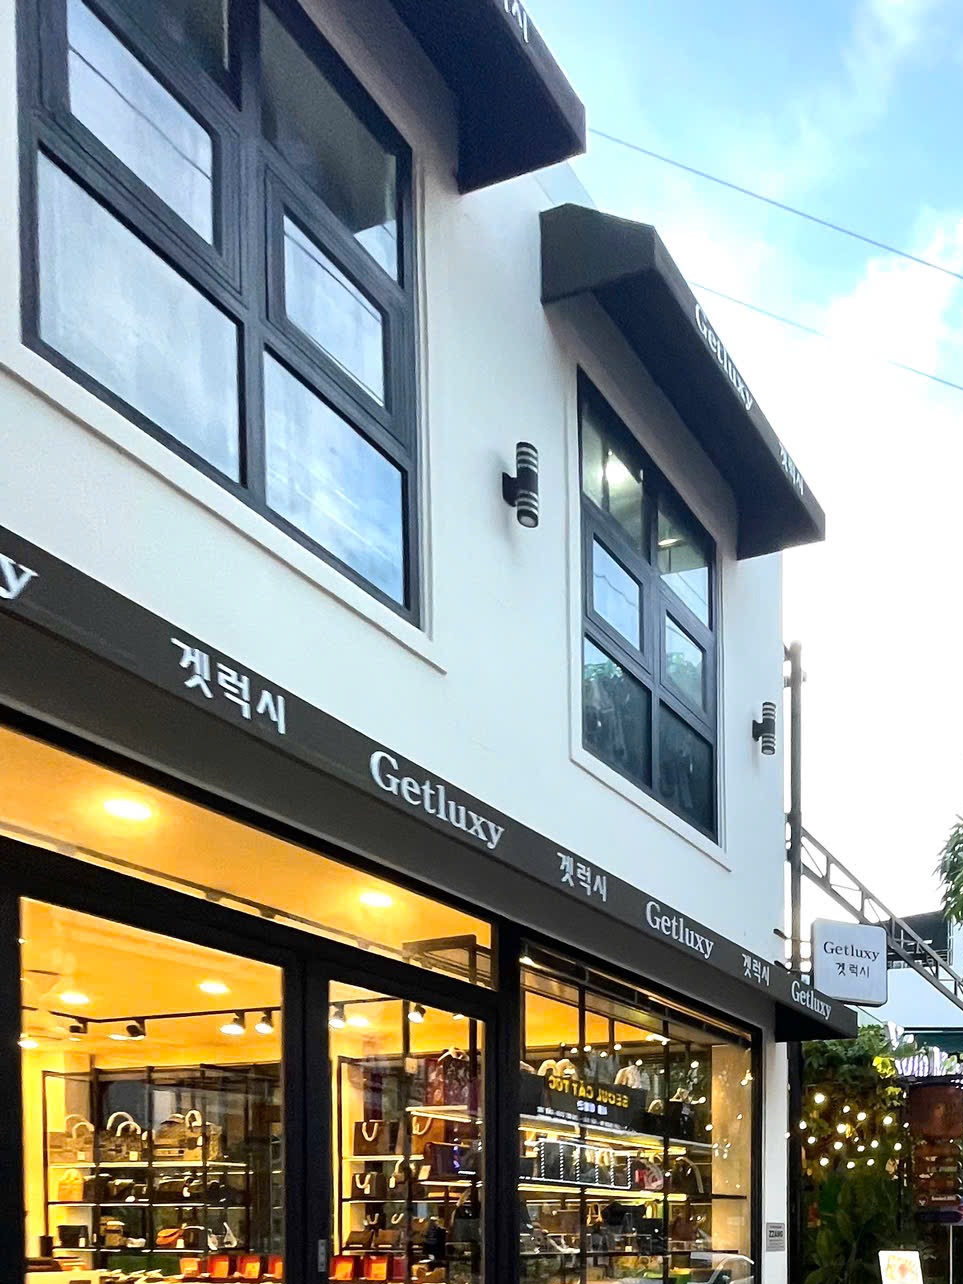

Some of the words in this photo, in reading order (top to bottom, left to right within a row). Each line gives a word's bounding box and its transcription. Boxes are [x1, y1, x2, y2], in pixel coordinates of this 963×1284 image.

[695, 303, 753, 411] Getluxy
[171, 637, 288, 735] 겟럭시
[369, 750, 504, 850] Getluxy
[556, 851, 608, 903] 겟럭시
[645, 900, 714, 960] Getluxy
[823, 941, 880, 962] Getluxy
[742, 953, 771, 986] 겟럭시
[791, 980, 832, 1021] Getluxy
